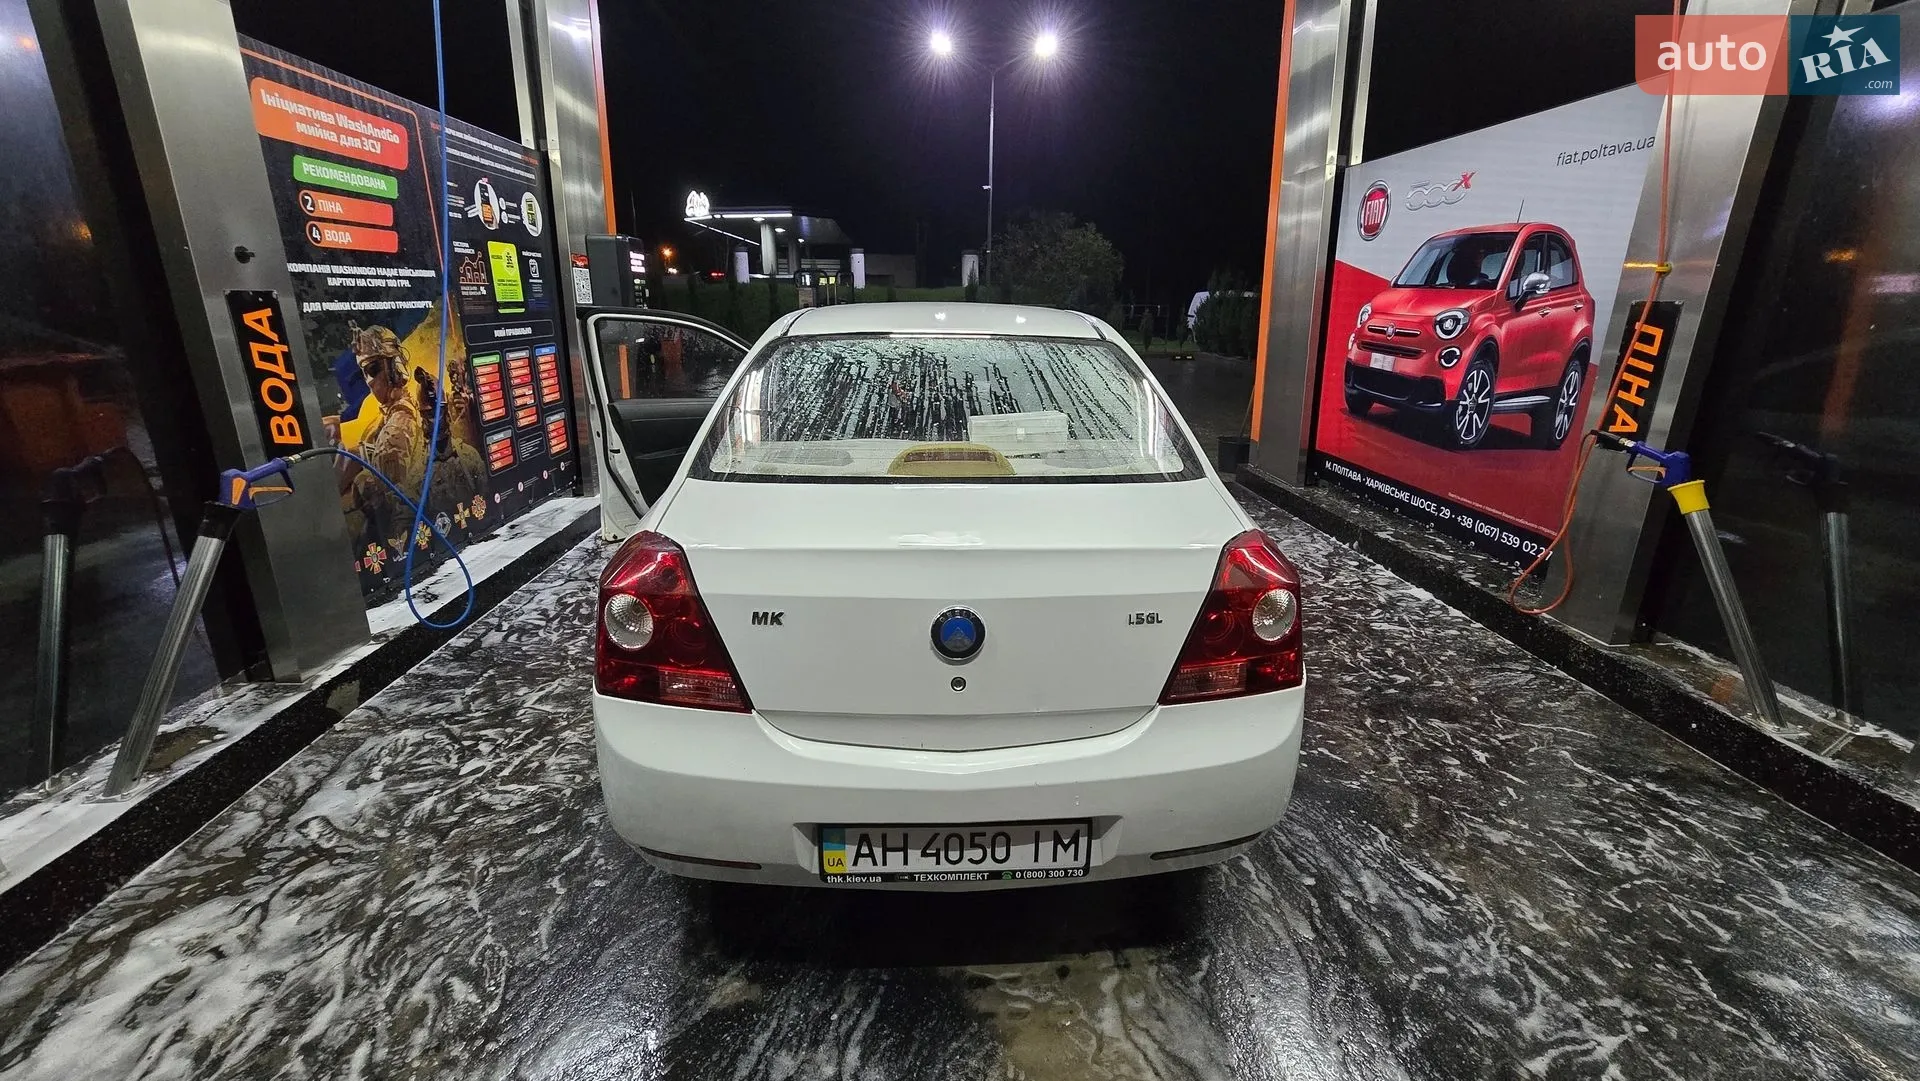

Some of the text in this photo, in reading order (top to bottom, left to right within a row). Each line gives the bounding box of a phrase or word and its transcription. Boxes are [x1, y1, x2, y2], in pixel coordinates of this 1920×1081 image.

[260, 88, 400, 144] Ініціатива WashAndGo
[340, 134, 362, 149] для
[362, 137, 381, 154] ЗСУ
[1555, 135, 1656, 167] fiat.poltava.ua
[302, 162, 387, 191] РЕКОМЕНДОВАНА
[304, 195, 344, 213] 2 ПІНА
[1364, 197, 1386, 226] FIAT
[312, 226, 352, 244] 4 ВОДА
[286, 262, 331, 273] КОМПАНІЯ
[331, 264, 376, 276] WASHANDGO
[327, 277, 356, 286] КАРТКУ
[357, 278, 367, 287] НА
[303, 302, 321, 313] ДЛЯ
[351, 301, 396, 310] СЛУЖБОВОГО
[242, 307, 304, 446] ВОДА
[1608, 321, 1664, 433] ПІНА
[1332, 463, 1362, 483] ПОЛТАВА
[1365, 476, 1411, 503] ХАРКІВСЬКЕ
[1411, 494, 1438, 517] ШОСЕ,
[1439, 506, 1451, 519] 29
[1456, 515, 1473, 529] +38
[1475, 519, 1500, 541] (067)
[1500, 531, 1520, 548] 539
[751, 611, 784, 626] MK
[852, 832, 909, 867] AH
[920, 831, 1011, 866] 4050
[827, 857, 844, 867] UA
[827, 875, 882, 883] thk.kiev.ua
[914, 872, 990, 882] ТЕХКОМПЛЕКТ
[1023, 870, 1046, 879] (800)
[1067, 869, 1084, 877] 730
